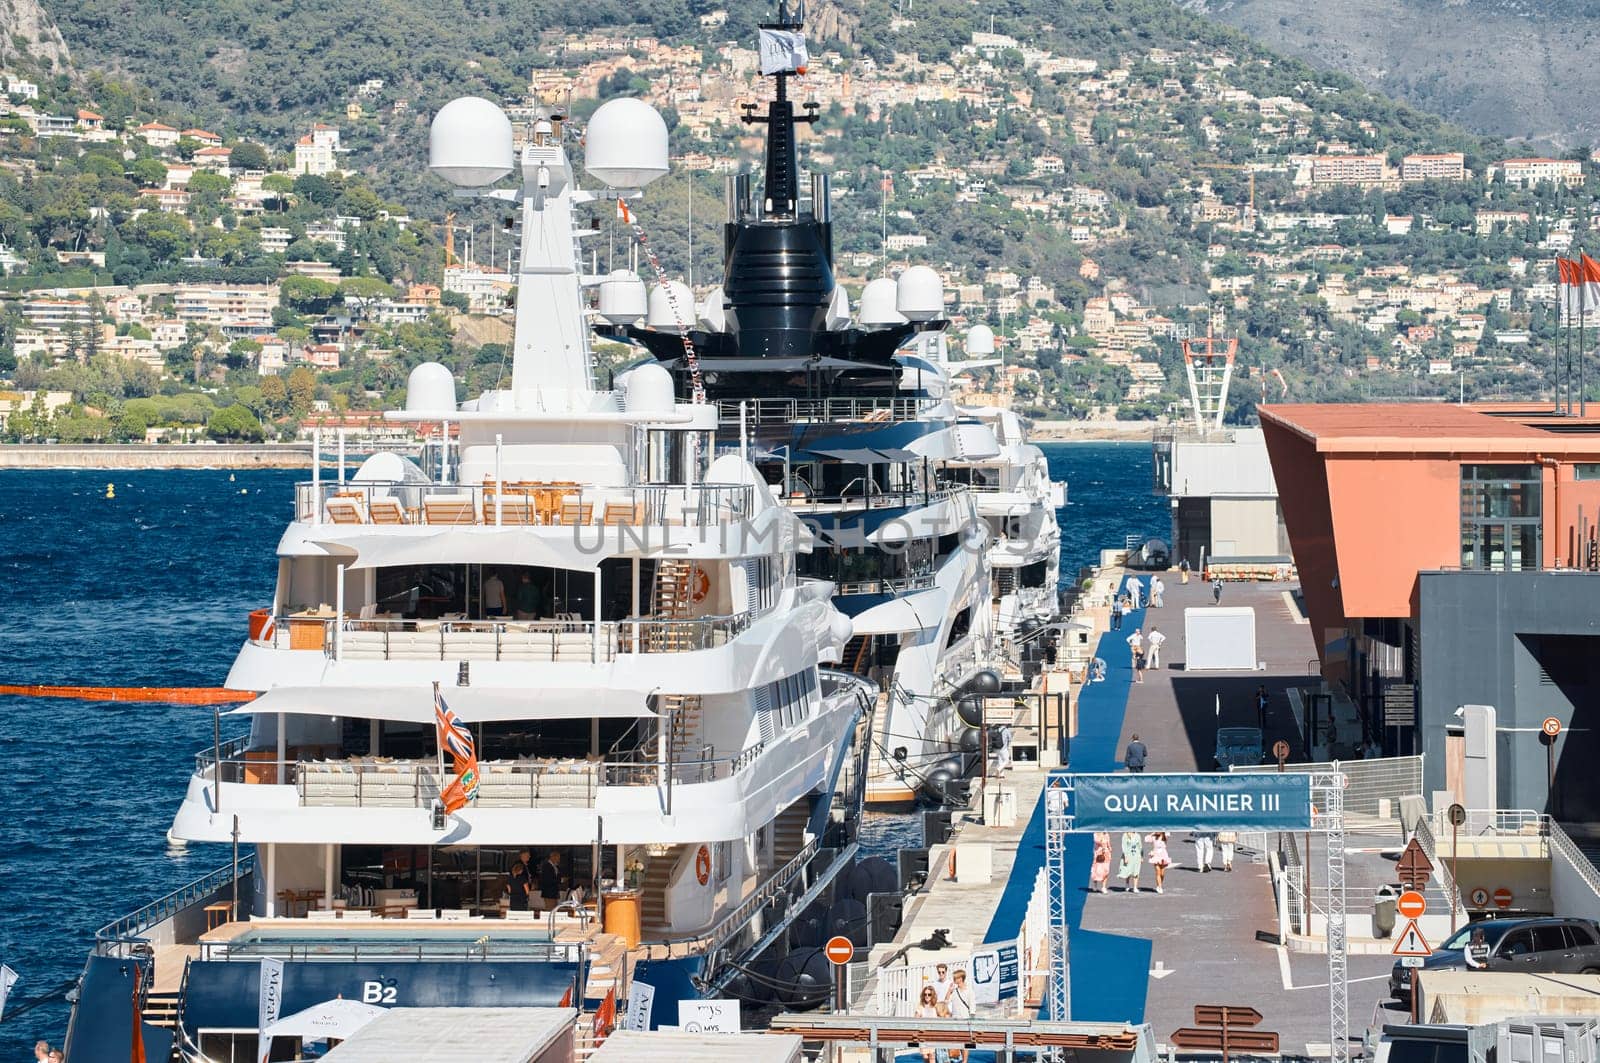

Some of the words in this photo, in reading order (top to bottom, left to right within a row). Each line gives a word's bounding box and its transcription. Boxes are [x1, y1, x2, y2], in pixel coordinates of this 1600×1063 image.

[1104, 794, 1158, 812] QUAI
[1167, 794, 1253, 812] RAINIER
[1261, 794, 1280, 811] III
[363, 981, 397, 1004] B2
